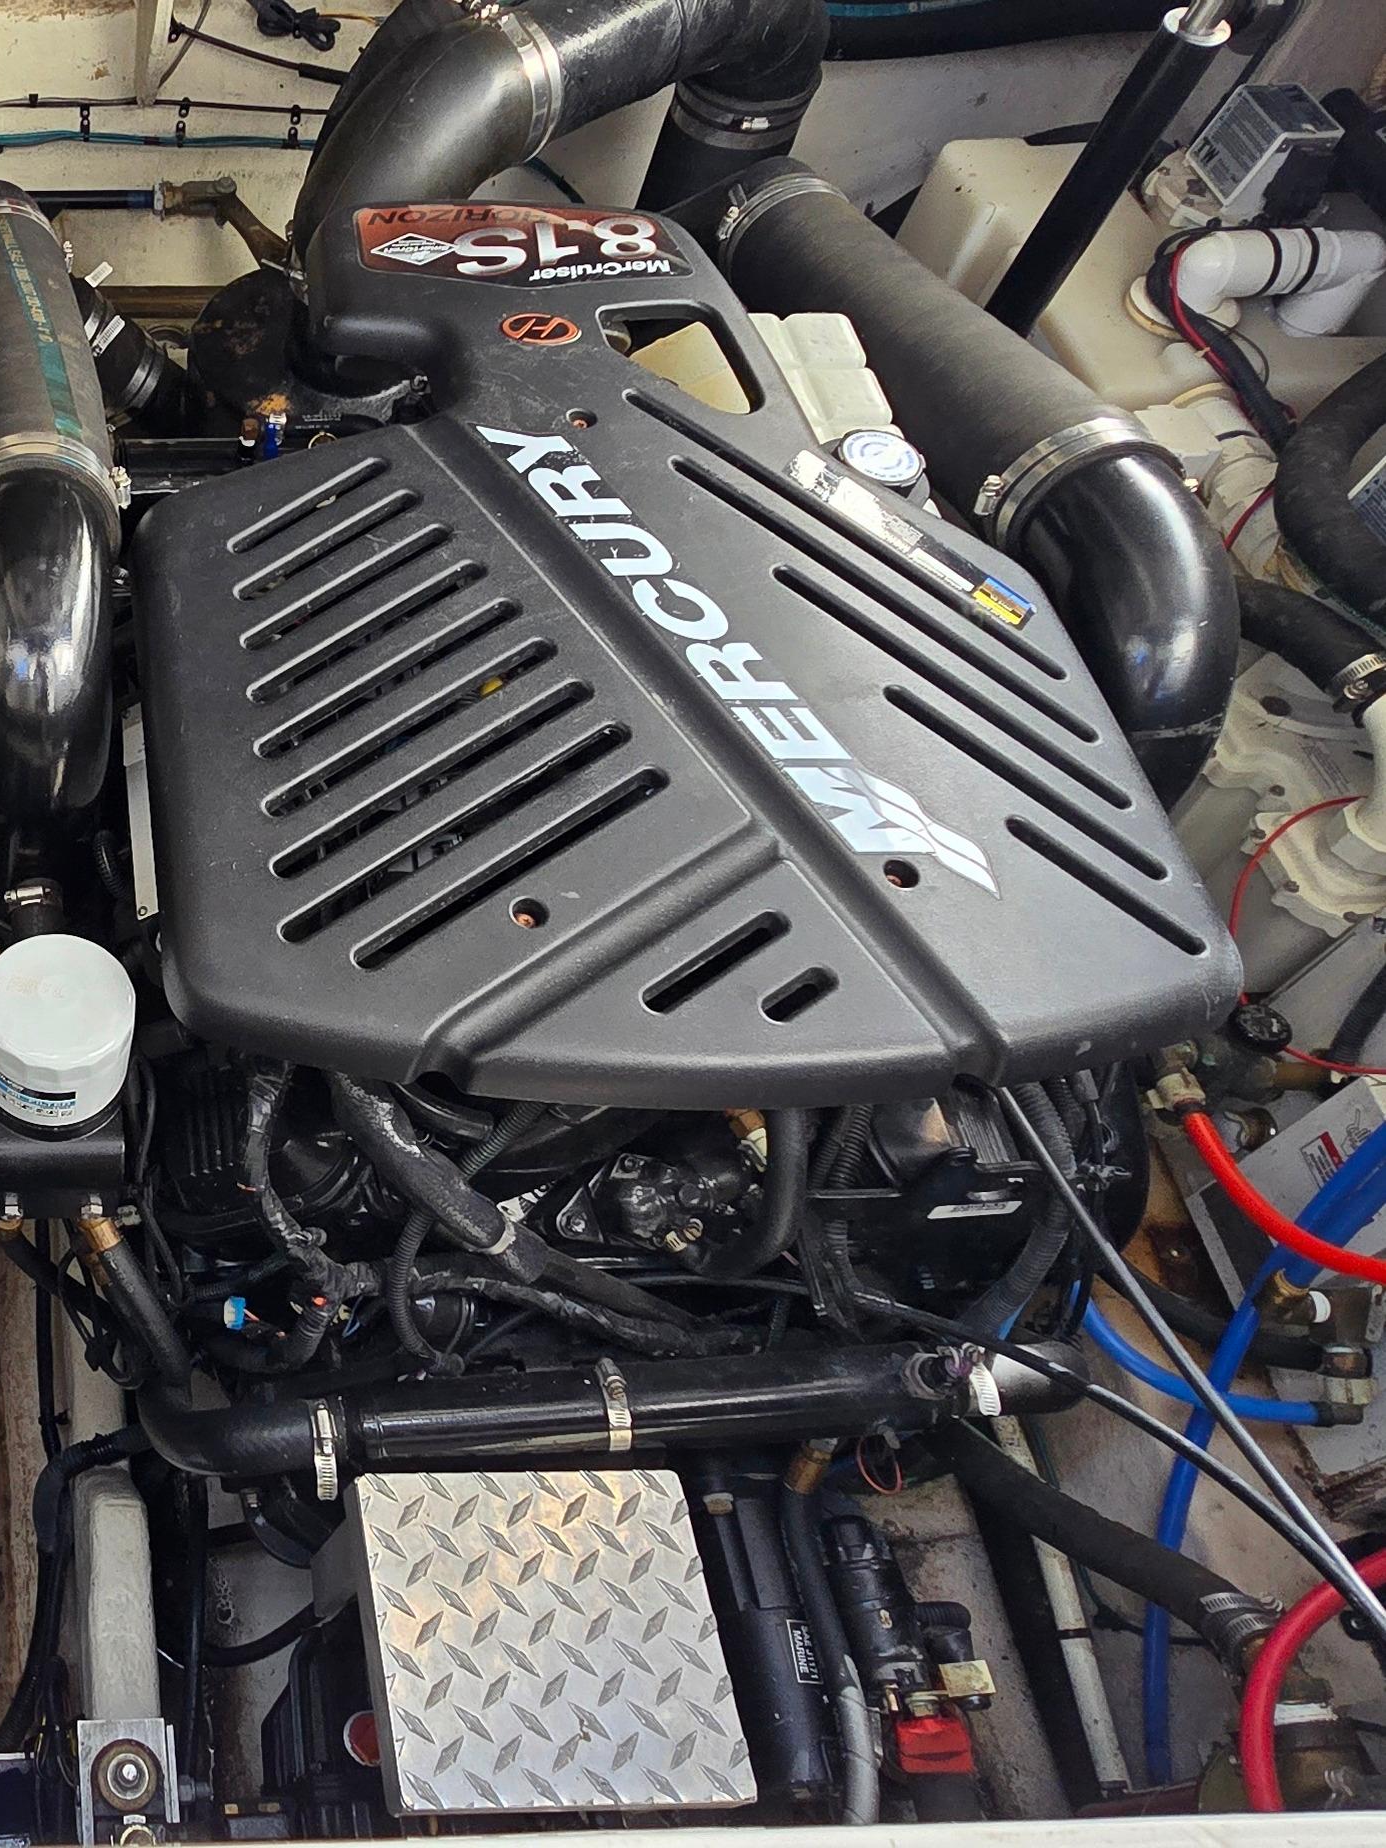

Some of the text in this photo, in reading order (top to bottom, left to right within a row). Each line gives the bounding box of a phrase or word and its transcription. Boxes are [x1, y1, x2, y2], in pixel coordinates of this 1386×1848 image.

[528, 259, 671, 281] MerCruiser
[476, 423, 1001, 899] MERCURY
[792, 1629, 809, 1673] MARINE
[800, 1625, 819, 1679] SAE J1171
